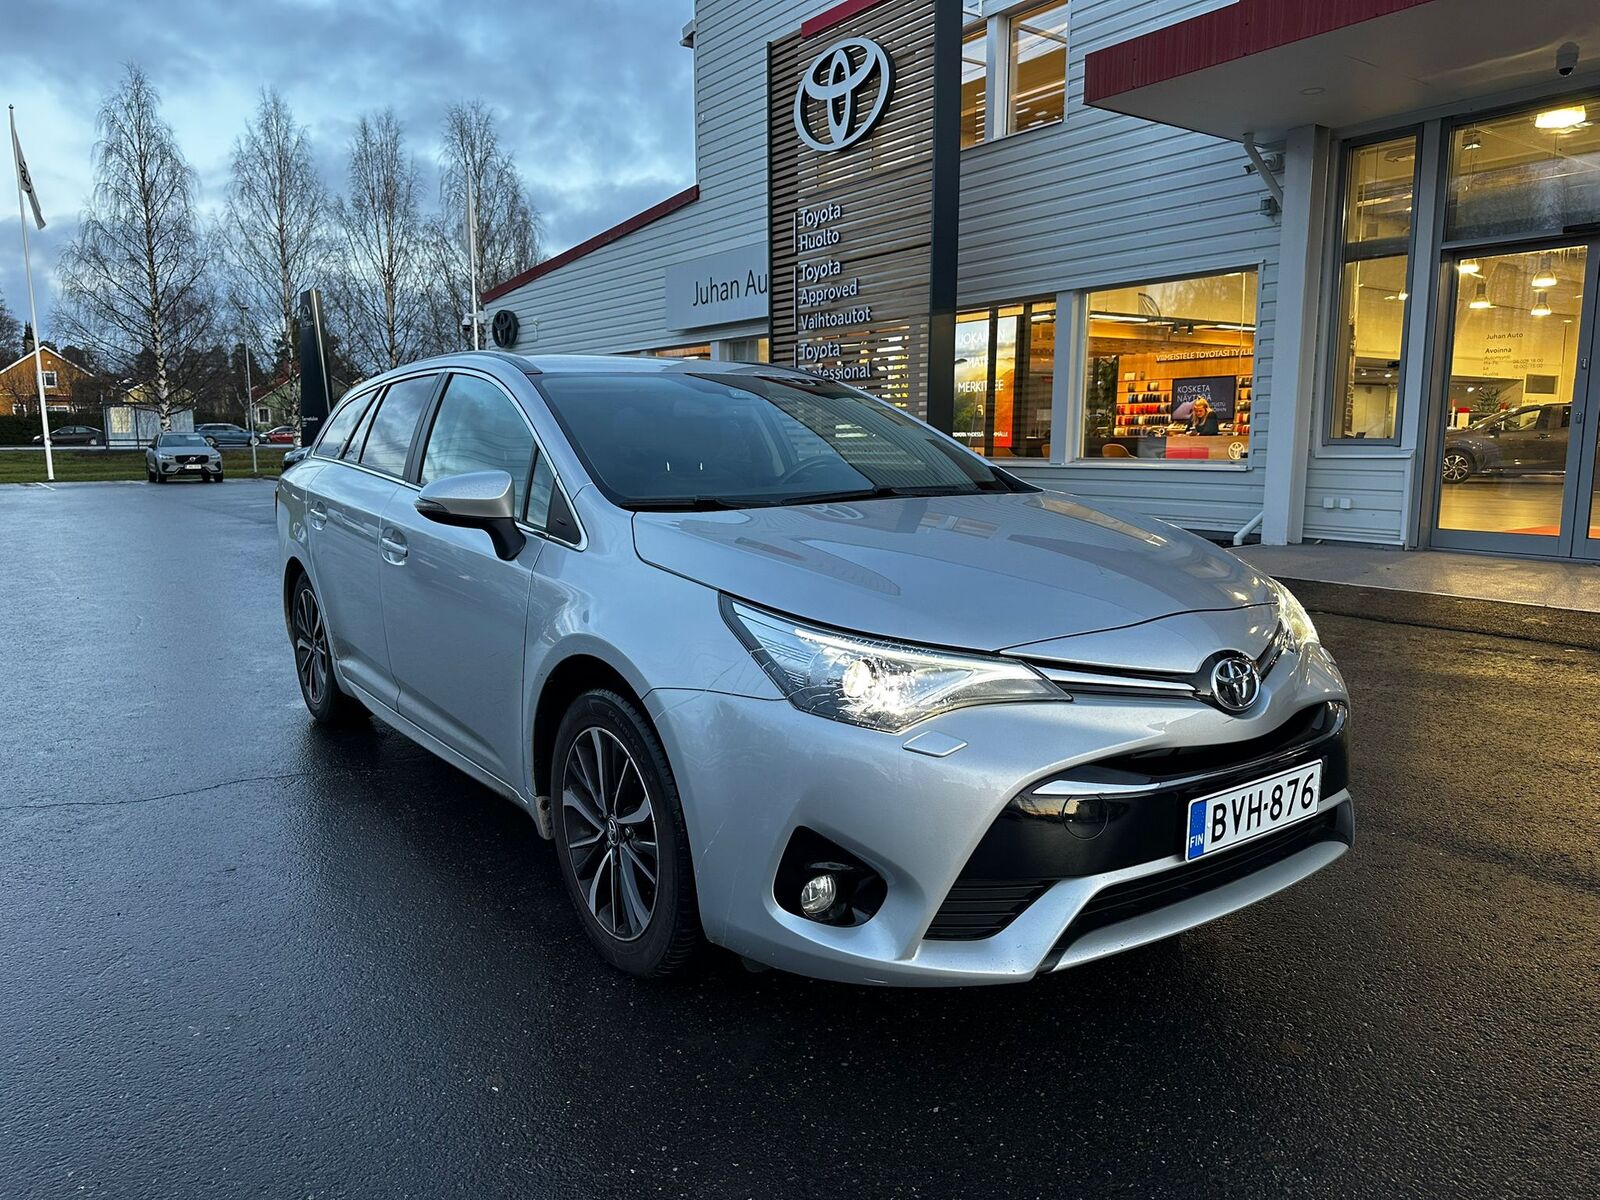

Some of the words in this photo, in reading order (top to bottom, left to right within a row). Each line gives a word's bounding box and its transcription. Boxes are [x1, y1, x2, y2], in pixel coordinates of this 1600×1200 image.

[801, 203, 842, 228] Toyota
[800, 228, 840, 251] Huolto
[801, 259, 841, 283] Toyota
[692, 276, 740, 306] Juhan
[744, 269, 768, 297] Au
[800, 277, 859, 306] Approved
[800, 306, 872, 331] Vaihtoautot
[960, 329, 1005, 345] JOKAIN
[800, 341, 841, 363] Toyota
[1196, 348, 1230, 359] TOYOTASI
[801, 361, 872, 380] fessional
[958, 379, 1005, 393] MERKITEE
[1177, 384, 1211, 394] KOSKETA
[1176, 393, 1213, 403] NÄYTÖÄ
[1210, 772, 1315, 844] BVH-876
[1189, 832, 1204, 849] FIN
